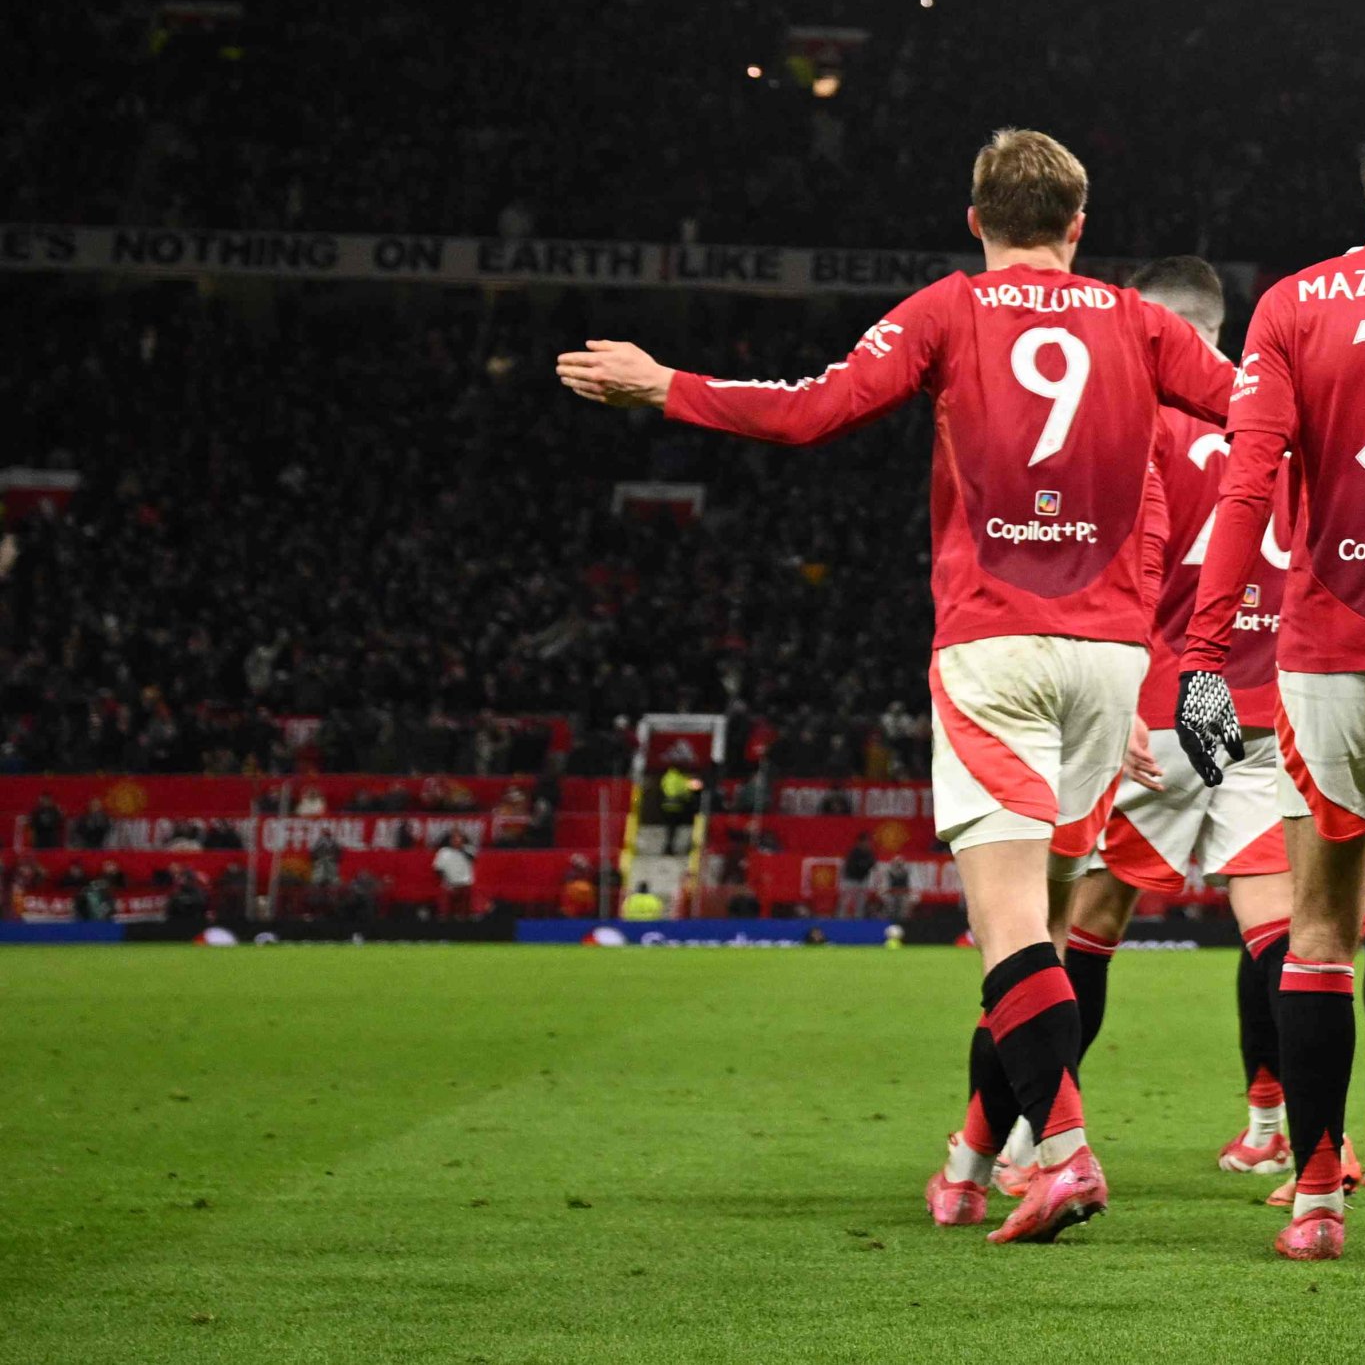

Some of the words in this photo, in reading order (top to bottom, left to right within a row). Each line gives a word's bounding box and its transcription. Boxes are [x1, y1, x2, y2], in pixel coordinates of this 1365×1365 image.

[112, 235, 338, 271] NOTHING
[373, 237, 443, 272] ON
[477, 241, 642, 278] EARTH
[675, 245, 784, 282] LIKE
[810, 248, 950, 285] BEING
[974, 284, 1117, 313] HØJLUND
[1011, 327, 1091, 467] 9
